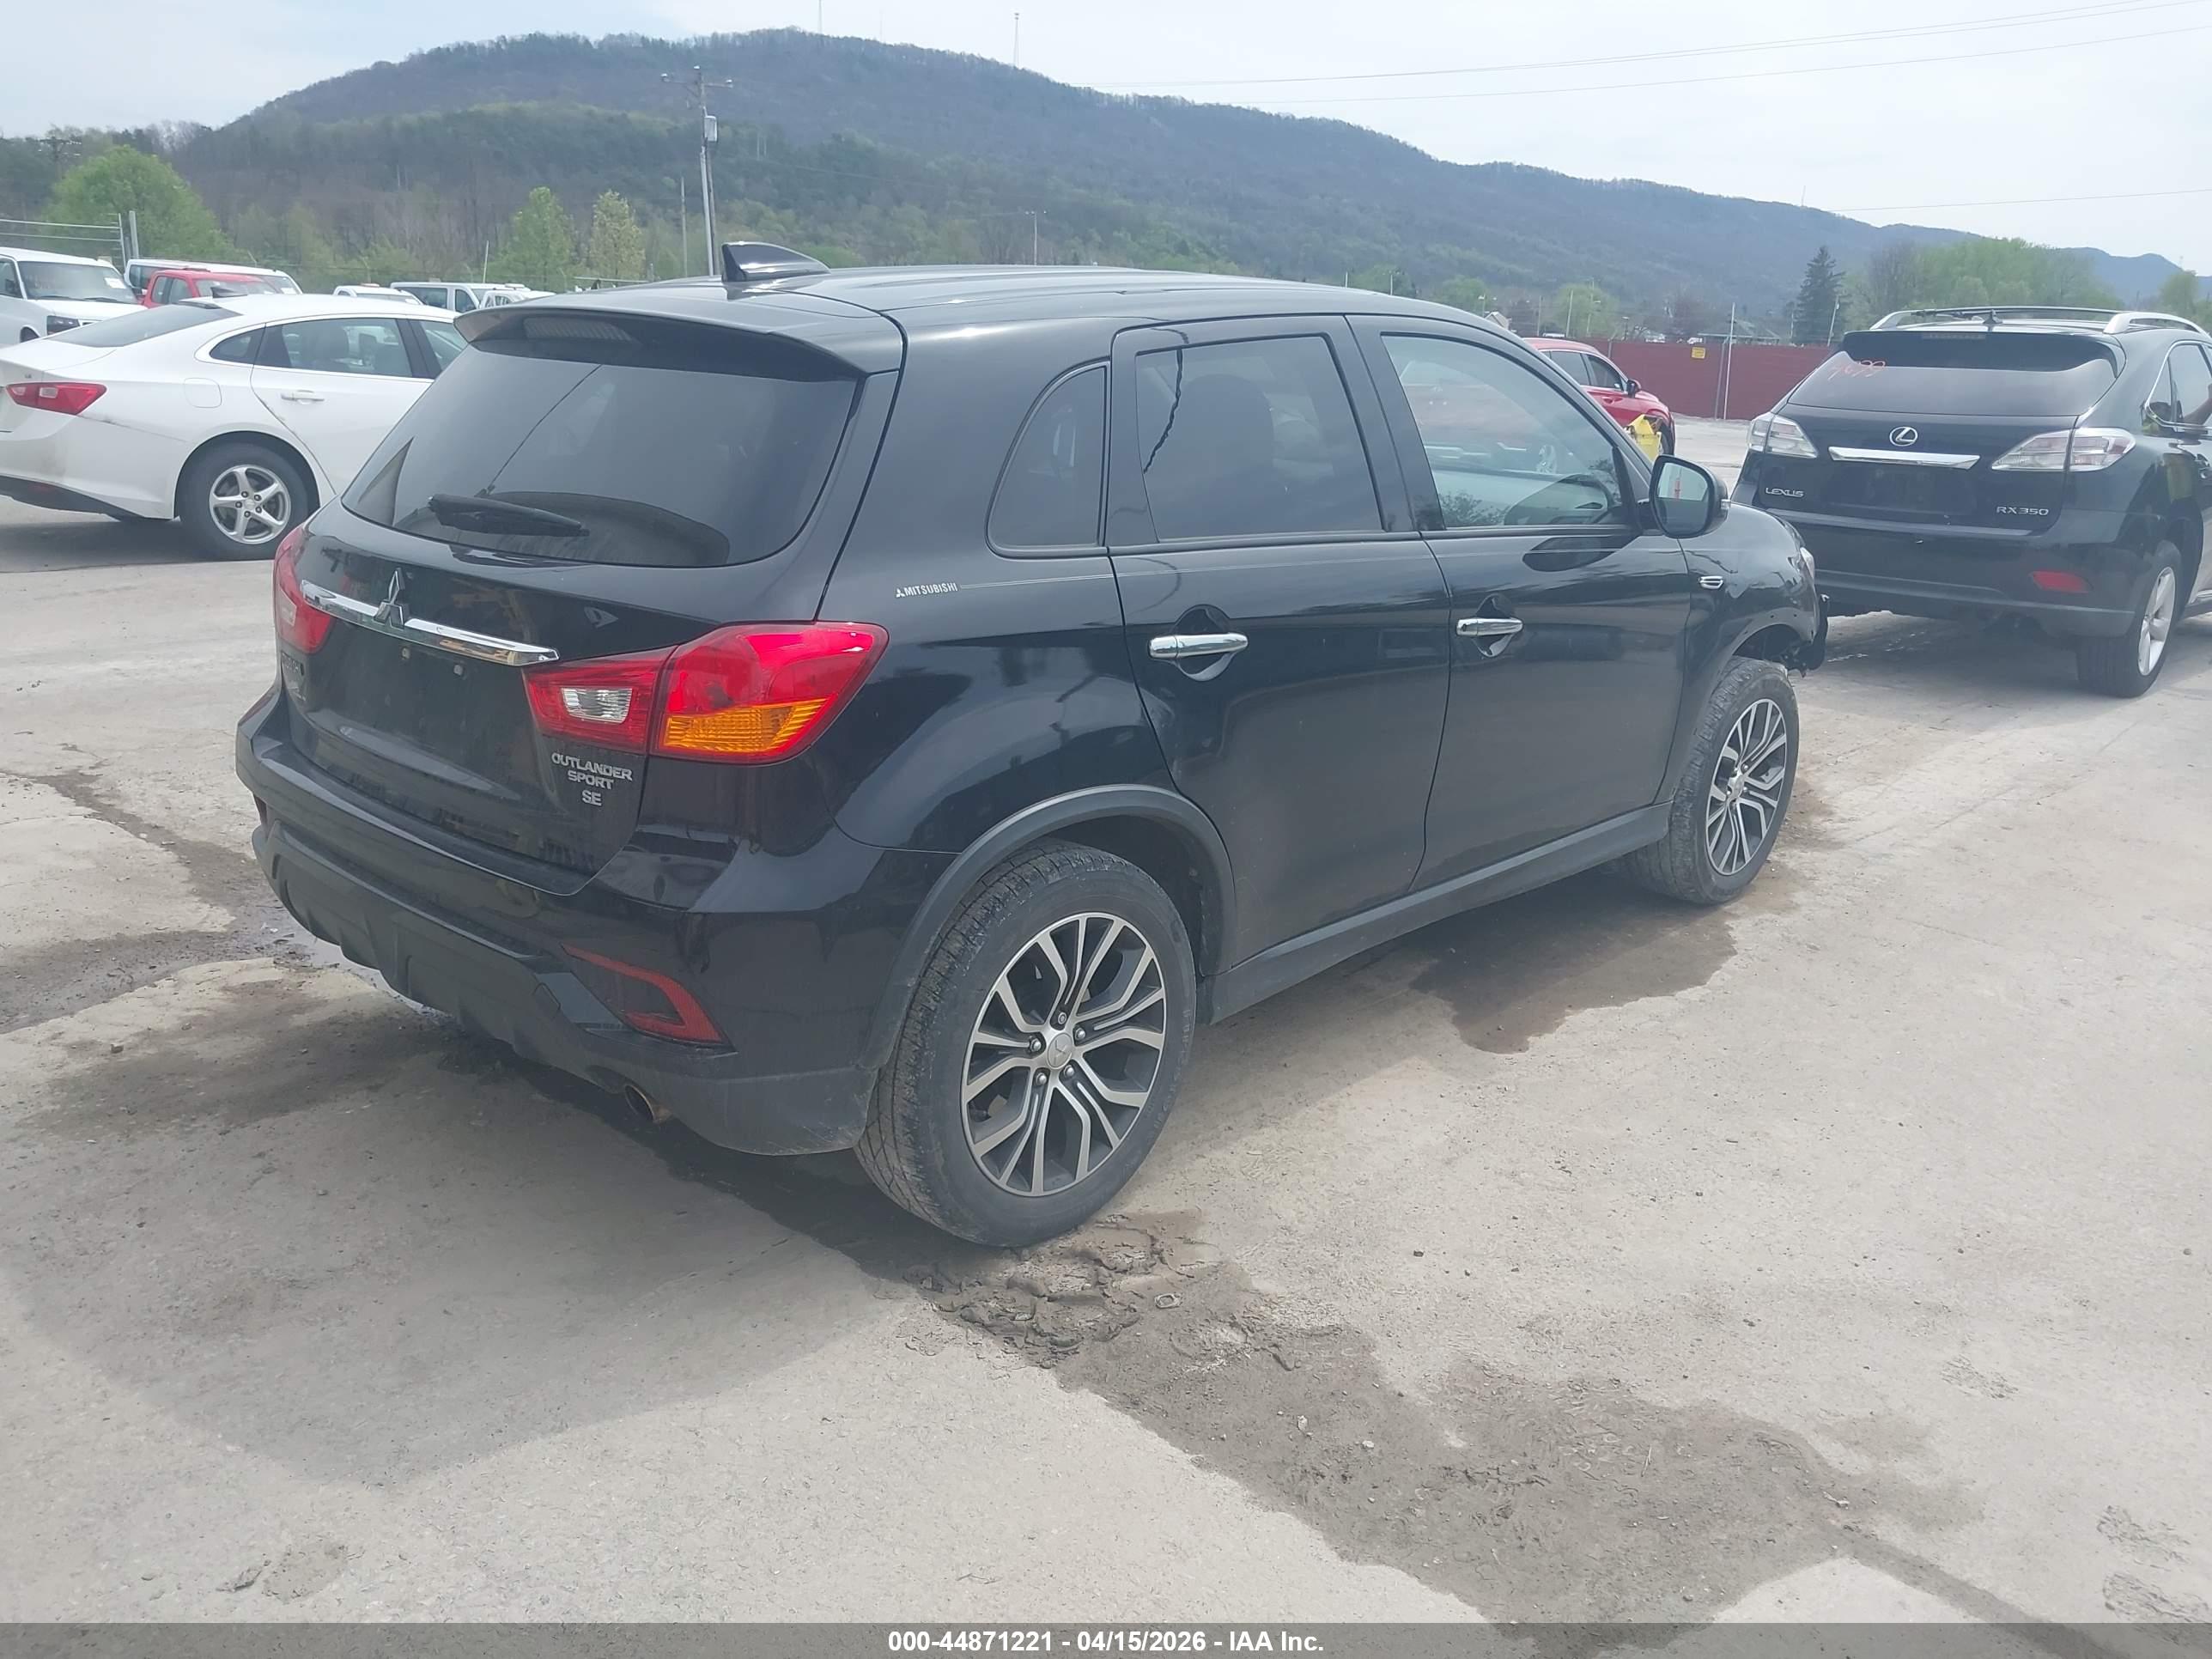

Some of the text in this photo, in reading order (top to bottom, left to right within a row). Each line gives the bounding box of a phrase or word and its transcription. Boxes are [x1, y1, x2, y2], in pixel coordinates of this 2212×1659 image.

[1765, 487, 1804, 498] LEXUS
[903, 583, 958, 596] MITSUBISHI
[551, 752, 633, 781] OUTLANDER
[568, 770, 614, 789] SPORT
[582, 790, 602, 806] SE
